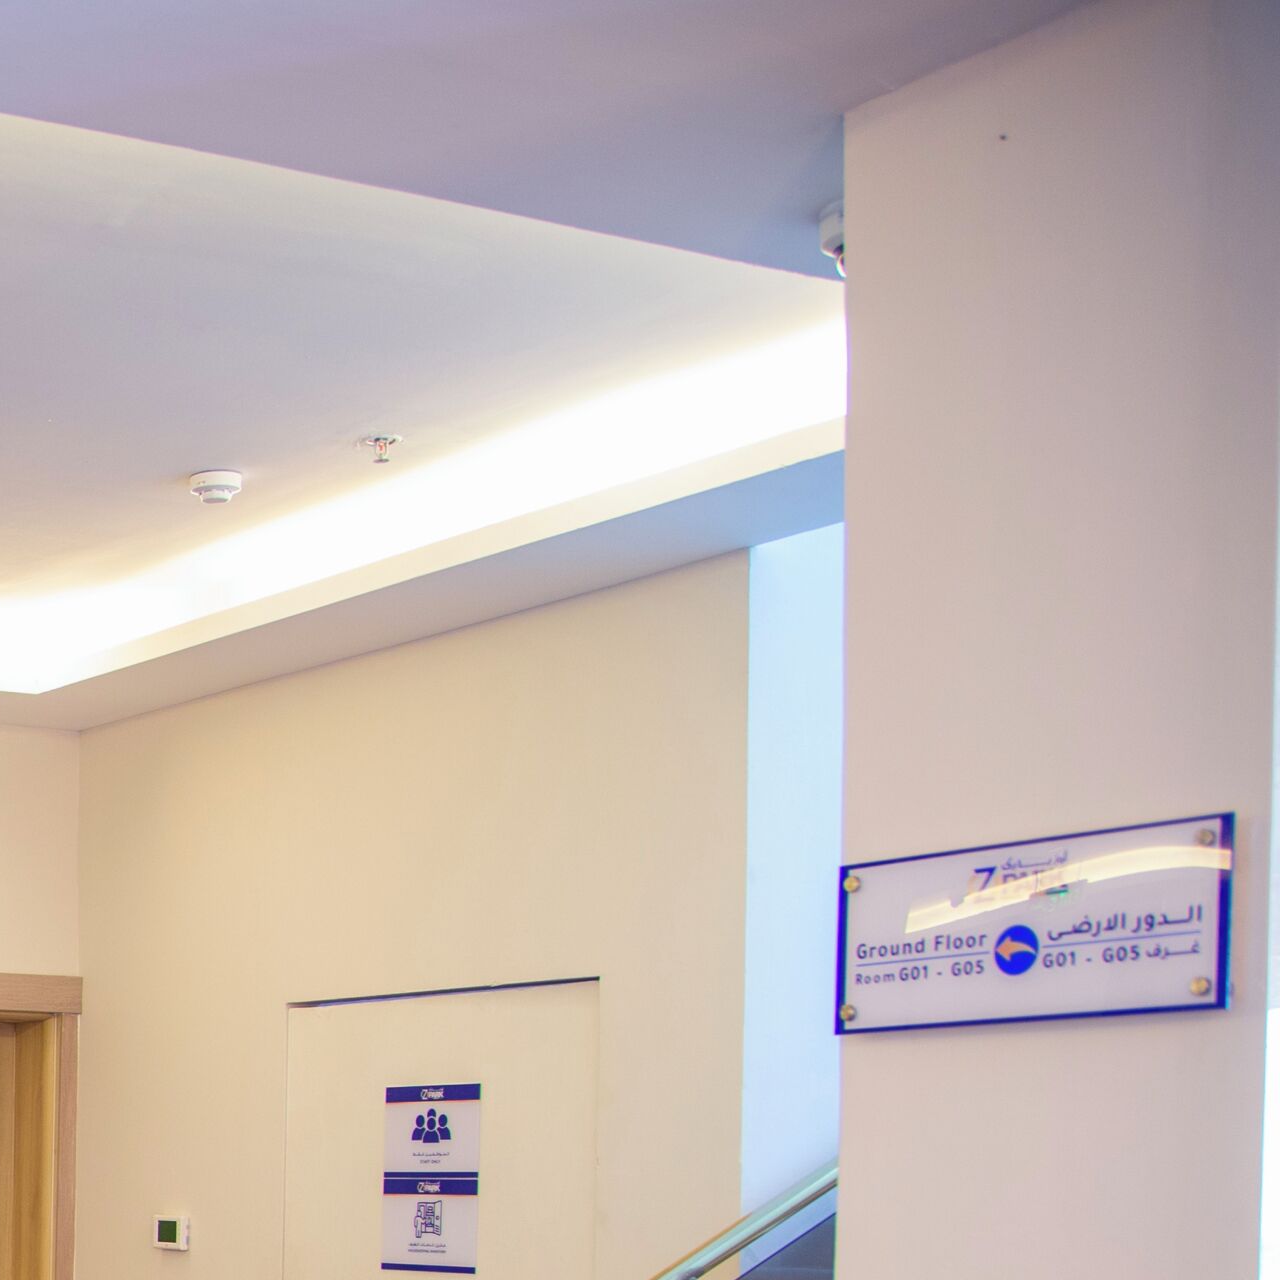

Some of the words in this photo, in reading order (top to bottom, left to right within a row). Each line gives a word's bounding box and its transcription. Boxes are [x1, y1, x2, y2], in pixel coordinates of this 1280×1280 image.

[856, 938, 927, 960] Ground
[934, 933, 988, 951] Floor
[1042, 951, 1077, 968] G01
[1102, 945, 1141, 963] G05
[855, 971, 896, 985] Room
[898, 965, 930, 982] G01
[951, 960, 986, 977] G05
